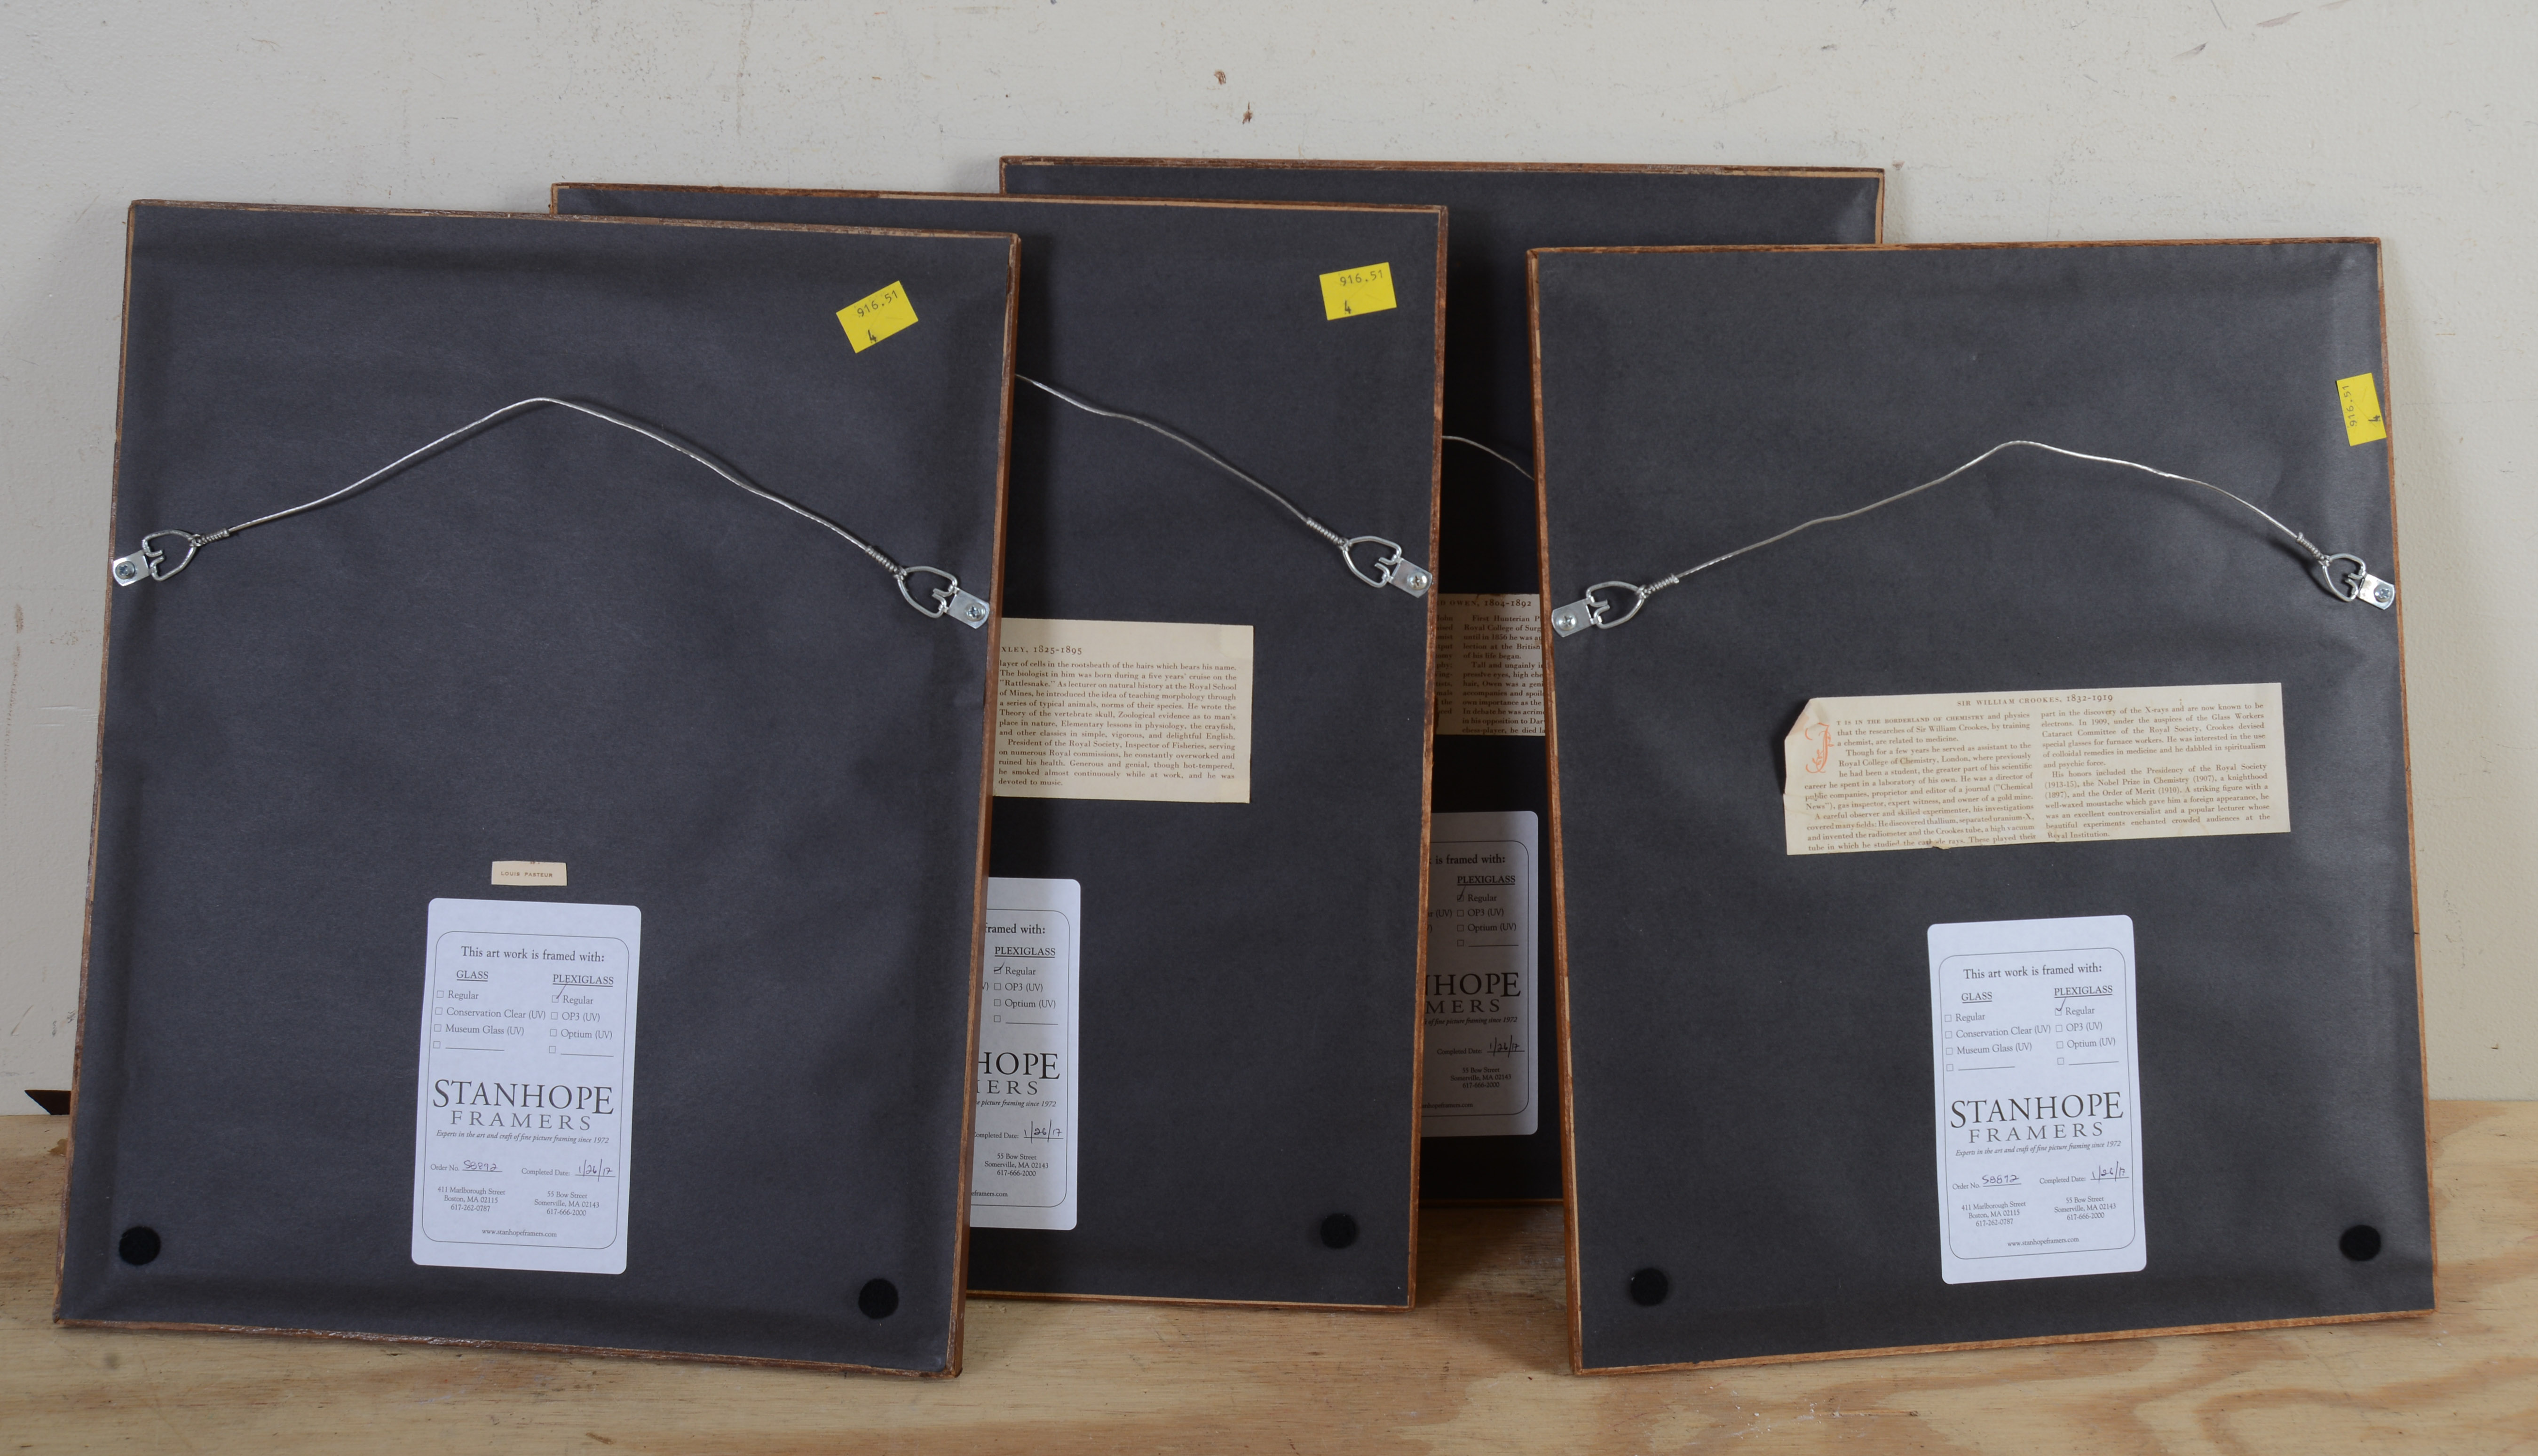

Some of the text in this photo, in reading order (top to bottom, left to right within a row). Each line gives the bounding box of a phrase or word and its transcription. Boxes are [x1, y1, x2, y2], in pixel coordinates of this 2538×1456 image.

[1340, 269, 1383, 286] 916.51
[857, 290, 898, 317] 916.51
[1344, 300, 1352, 314] 4
[868, 330, 877, 343] 4
[2342, 385, 2357, 426] 916.51
[1485, 599, 1531, 608] 1804-1892
[1464, 624, 1485, 632] Royal
[1487, 624, 1513, 633] College
[1034, 645, 1082, 655] 1825-1895
[999, 659, 1019, 669] layer
[2066, 694, 2113, 703] 1832-1919
[2004, 712, 2030, 721] physics
[1435, 853, 1505, 865] is framed with:
[1457, 875, 1516, 884] PLEXIGLASS
[1468, 893, 1497, 904] Regular
[985, 922, 1045, 934] ramed with:
[461, 945, 483, 957] This
[504, 948, 528, 959] work
[532, 949, 539, 960] is
[543, 949, 576, 961] framed
[579, 951, 604, 962] with:
[995, 946, 1056, 956] PLEXIGLASS
[456, 970, 489, 980] GLASS
[1005, 966, 1036, 976] Regular
[1963, 968, 1985, 979] This
[2005, 966, 2028, 977] work
[2032, 966, 2039, 976] is
[2042, 963, 2074, 975] framed
[2077, 962, 2102, 973] with:
[553, 974, 614, 985] PLEXIGLASS
[1004, 982, 1043, 992] OP3 (UV)
[2054, 985, 2113, 996] PLEXIGLASS
[448, 990, 479, 1001] Regular
[563, 995, 594, 1006] Regular
[1961, 992, 1992, 1001] GLASS
[1004, 999, 1056, 1009] Optium (UV)
[446, 1007, 546, 1020] Conservation Clear (UV)
[561, 1011, 600, 1023] OP3 (UV)
[2065, 1006, 2095, 1017] Regular
[1955, 1012, 1985, 1023] Regular
[445, 1023, 524, 1036] Museum Glass (UV)
[561, 1029, 612, 1040] Optium (UV)
[1437, 1047, 1467, 1056] Completed
[977, 1080, 1038, 1095] ERS
[433, 1079, 614, 1115] STANHOPE
[1001, 1100, 1024, 1108] framing
[1950, 1092, 2124, 1128] STANHOPE
[451, 1110, 590, 1131] FRAMERS
[436, 1130, 457, 1138] Experts
[514, 1133, 521, 1141] of
[553, 1134, 577, 1144] framing
[1969, 1122, 2103, 1143] FRAMERS
[521, 1167, 553, 1176] Completed
[2039, 1176, 2070, 1185] Completed
[450, 1186, 487, 1196] Marlborough
[451, 1204, 490, 1212] 617-262-0787
[534, 1199, 567, 1207] Somerville,
[546, 1208, 586, 1216] 617-666-2000
[482, 1228, 557, 1237] www.stanhopeframers.com
[2007, 1237, 2079, 1246] www.stanhopeframers.com
